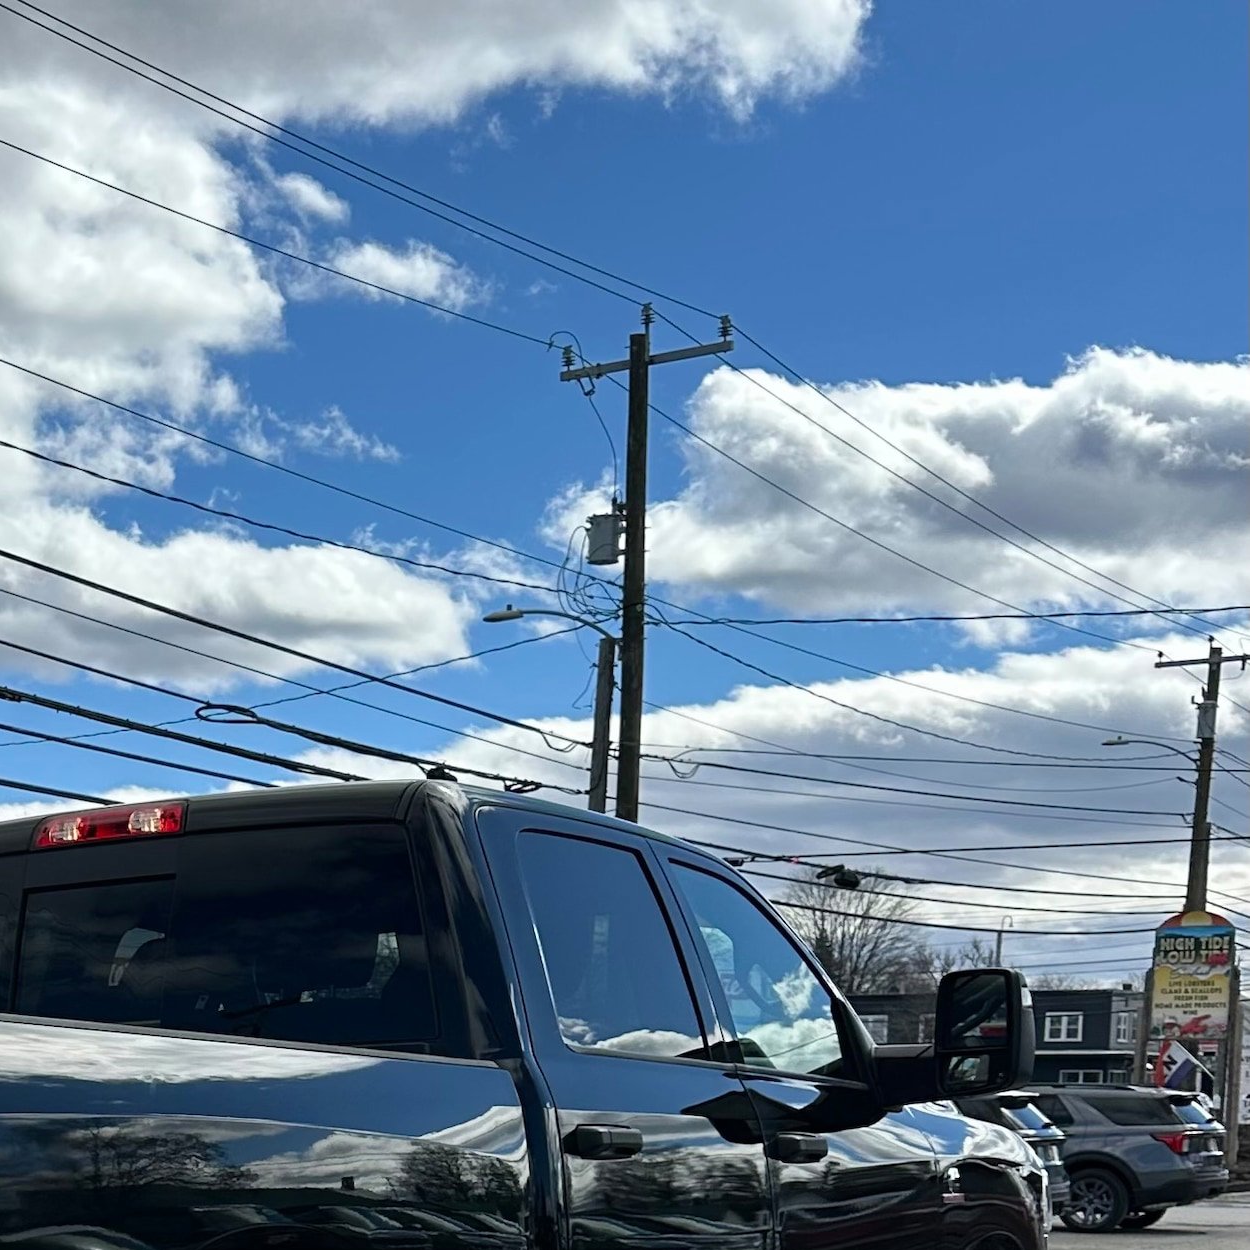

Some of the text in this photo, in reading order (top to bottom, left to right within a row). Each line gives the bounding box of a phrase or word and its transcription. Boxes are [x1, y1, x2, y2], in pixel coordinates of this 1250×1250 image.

[1160, 936, 1230, 950] HIGH TIDE
[1160, 950, 1196, 963] LOW
